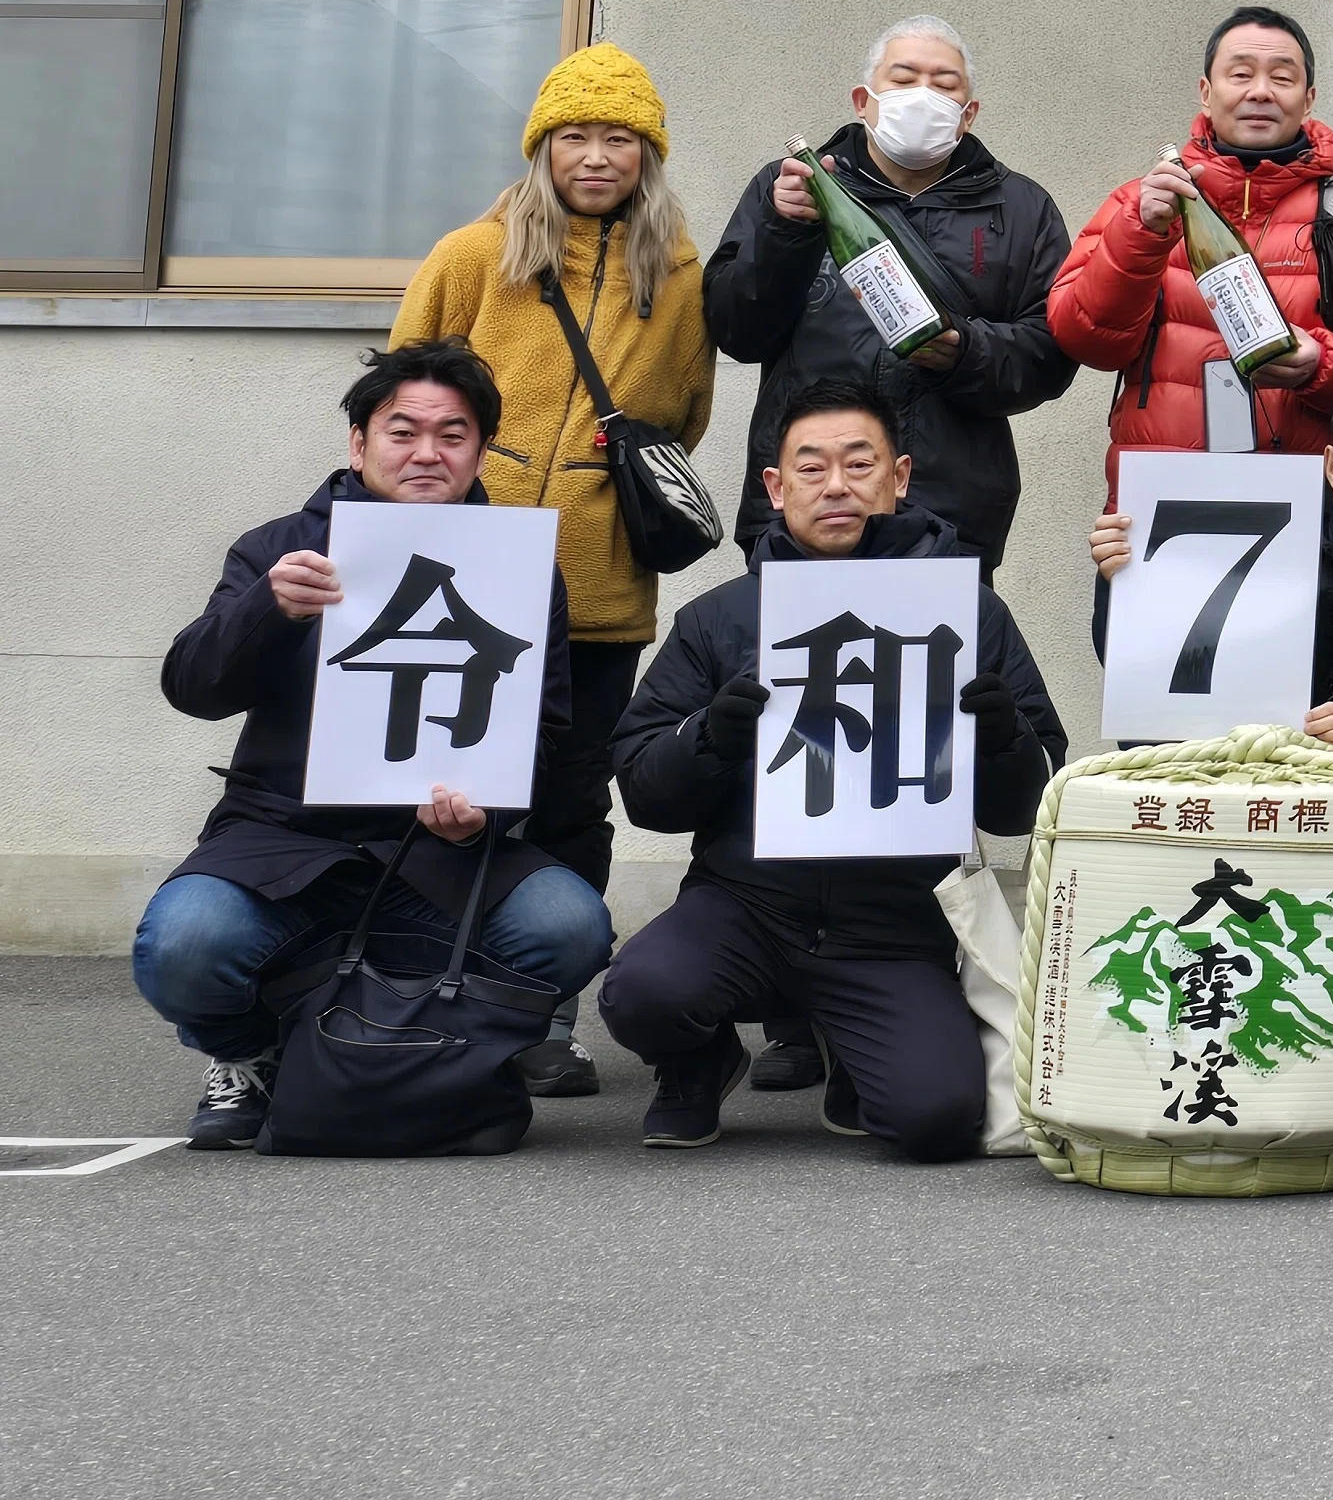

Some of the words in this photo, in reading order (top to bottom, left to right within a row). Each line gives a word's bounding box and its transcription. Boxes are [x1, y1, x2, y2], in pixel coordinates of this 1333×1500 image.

[326, 553, 533, 762] 令
[1143, 500, 1292, 694] 7
[767, 611, 964, 818] 和
[1161, 857, 1270, 1127] 大雪渓
